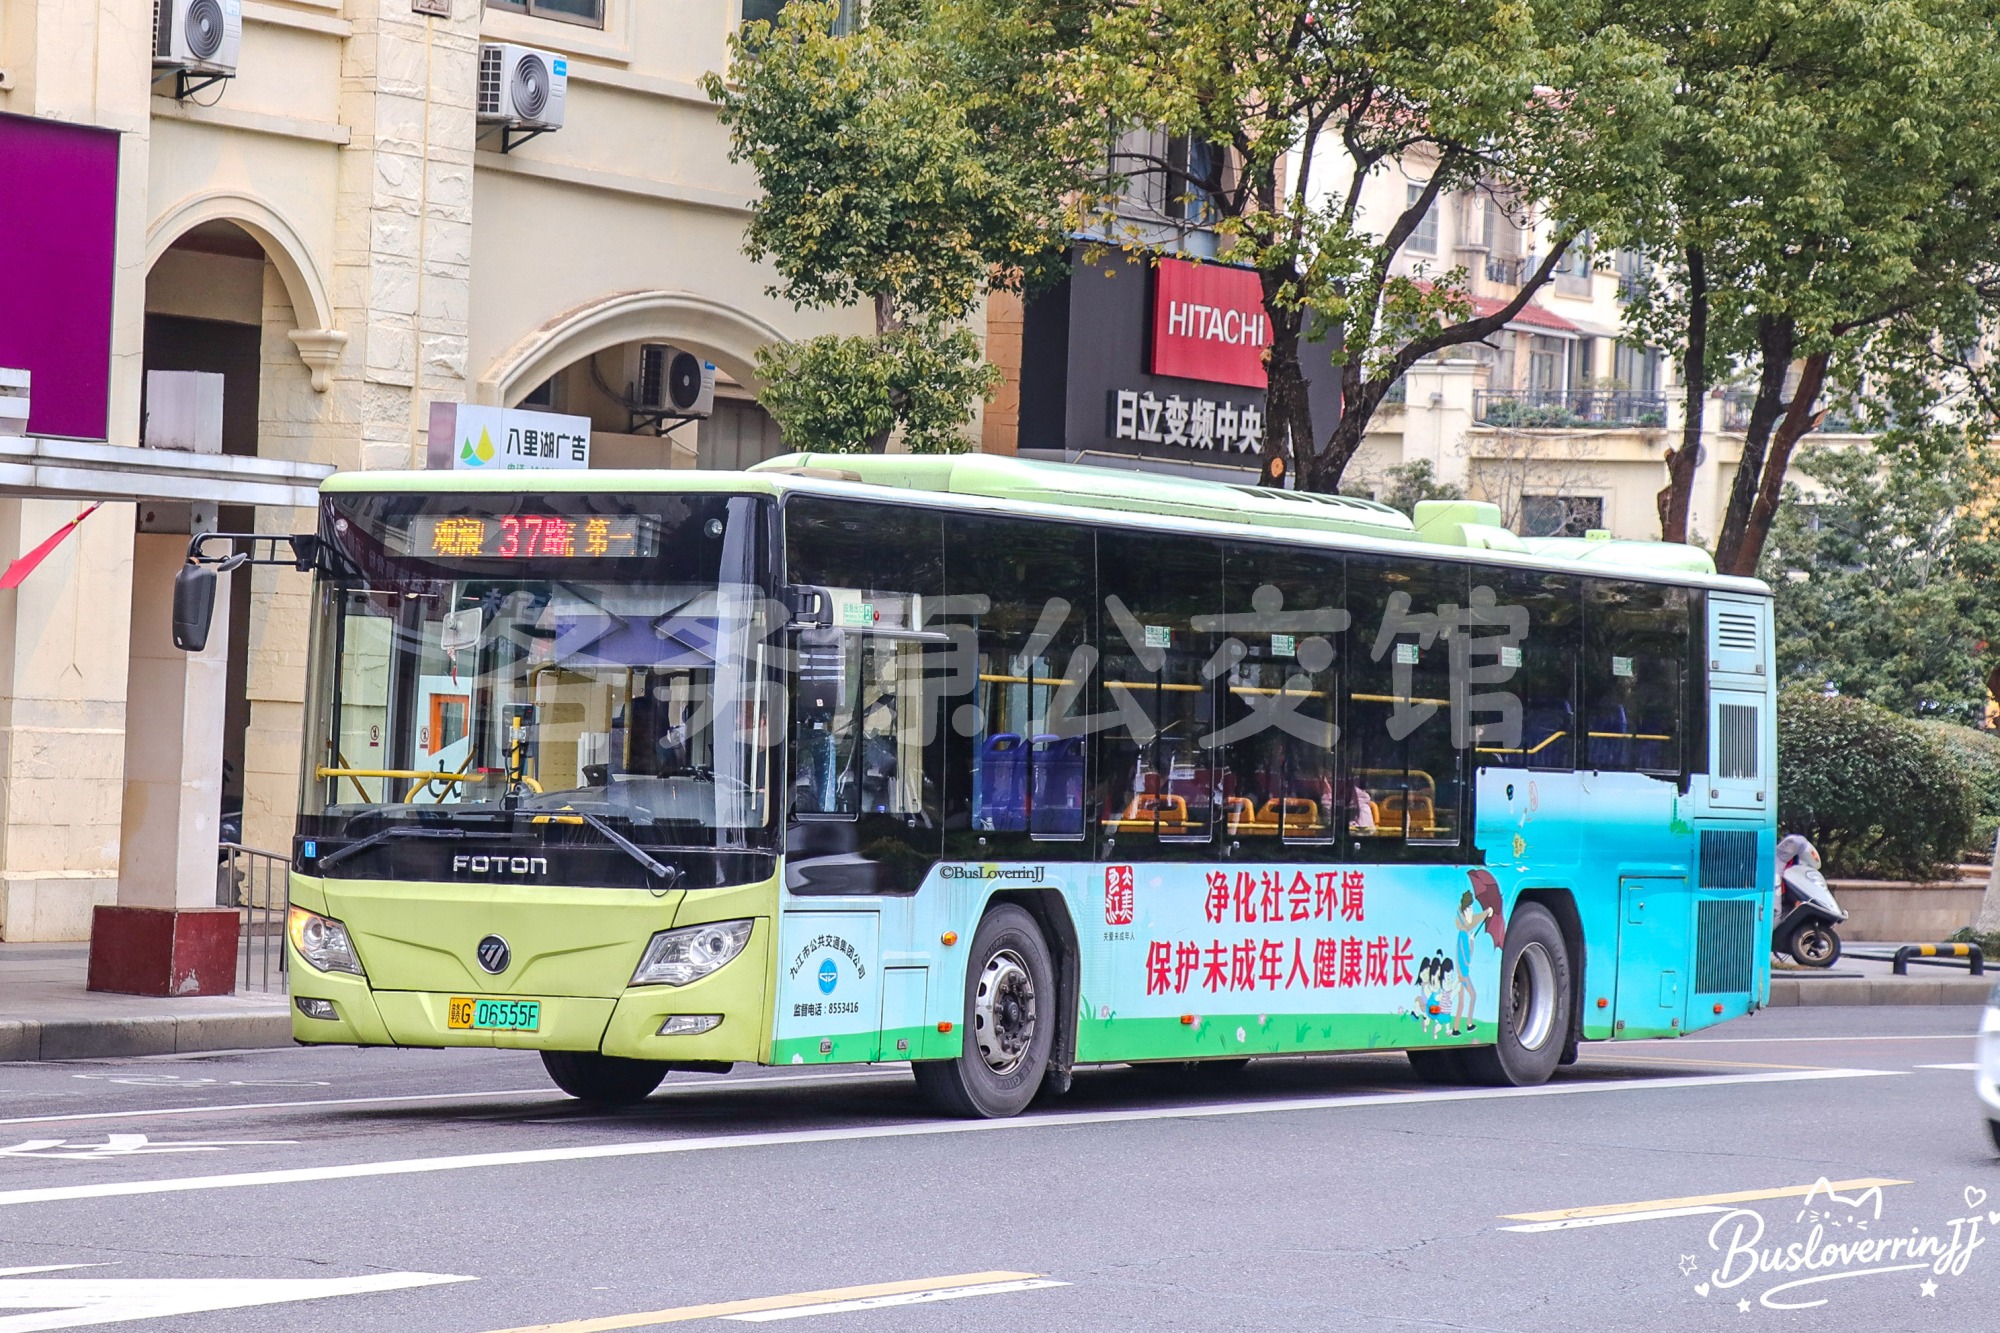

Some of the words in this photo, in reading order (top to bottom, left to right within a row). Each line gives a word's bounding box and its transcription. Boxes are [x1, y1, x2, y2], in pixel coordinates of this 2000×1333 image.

[1167, 300, 1265, 347] HITACHI
[506, 427, 586, 462] 八里湖广告
[1115, 389, 1264, 455] 日立变频中央
[453, 855, 548, 875] FOTON
[1204, 869, 1366, 924] 净化社会环境
[789, 933, 866, 980] 九江市公共交通集团公司
[1145, 936, 1415, 997] 保护未成年人健康成长
